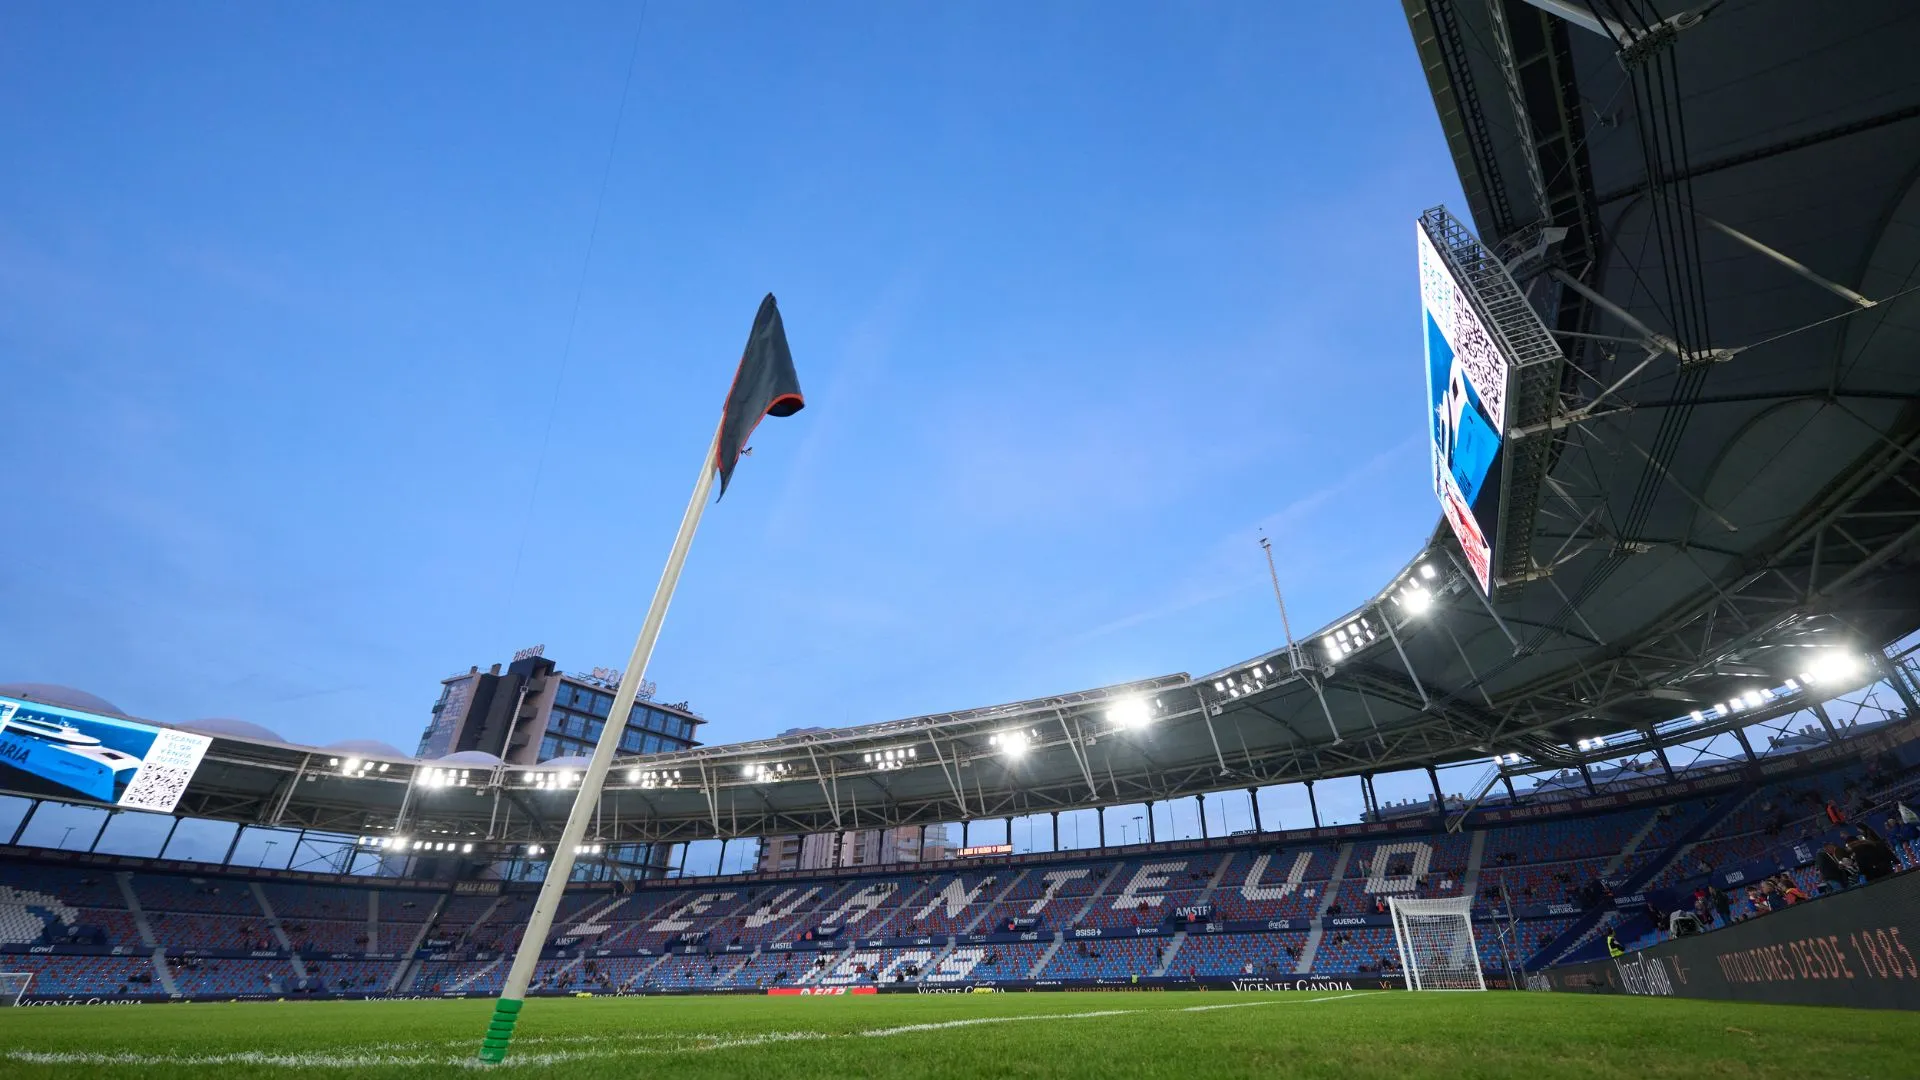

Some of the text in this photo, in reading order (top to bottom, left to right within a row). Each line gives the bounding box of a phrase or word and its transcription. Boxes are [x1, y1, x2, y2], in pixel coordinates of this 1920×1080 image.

[1333, 918, 1366, 926] GUEROLA
[1075, 929, 1096, 937] asisa
[770, 942, 793, 950] AMSTEL
[1717, 926, 1918, 984] VITICULTORES DESDE 1885
[1231, 979, 1352, 992] VICENTE GANDIA
